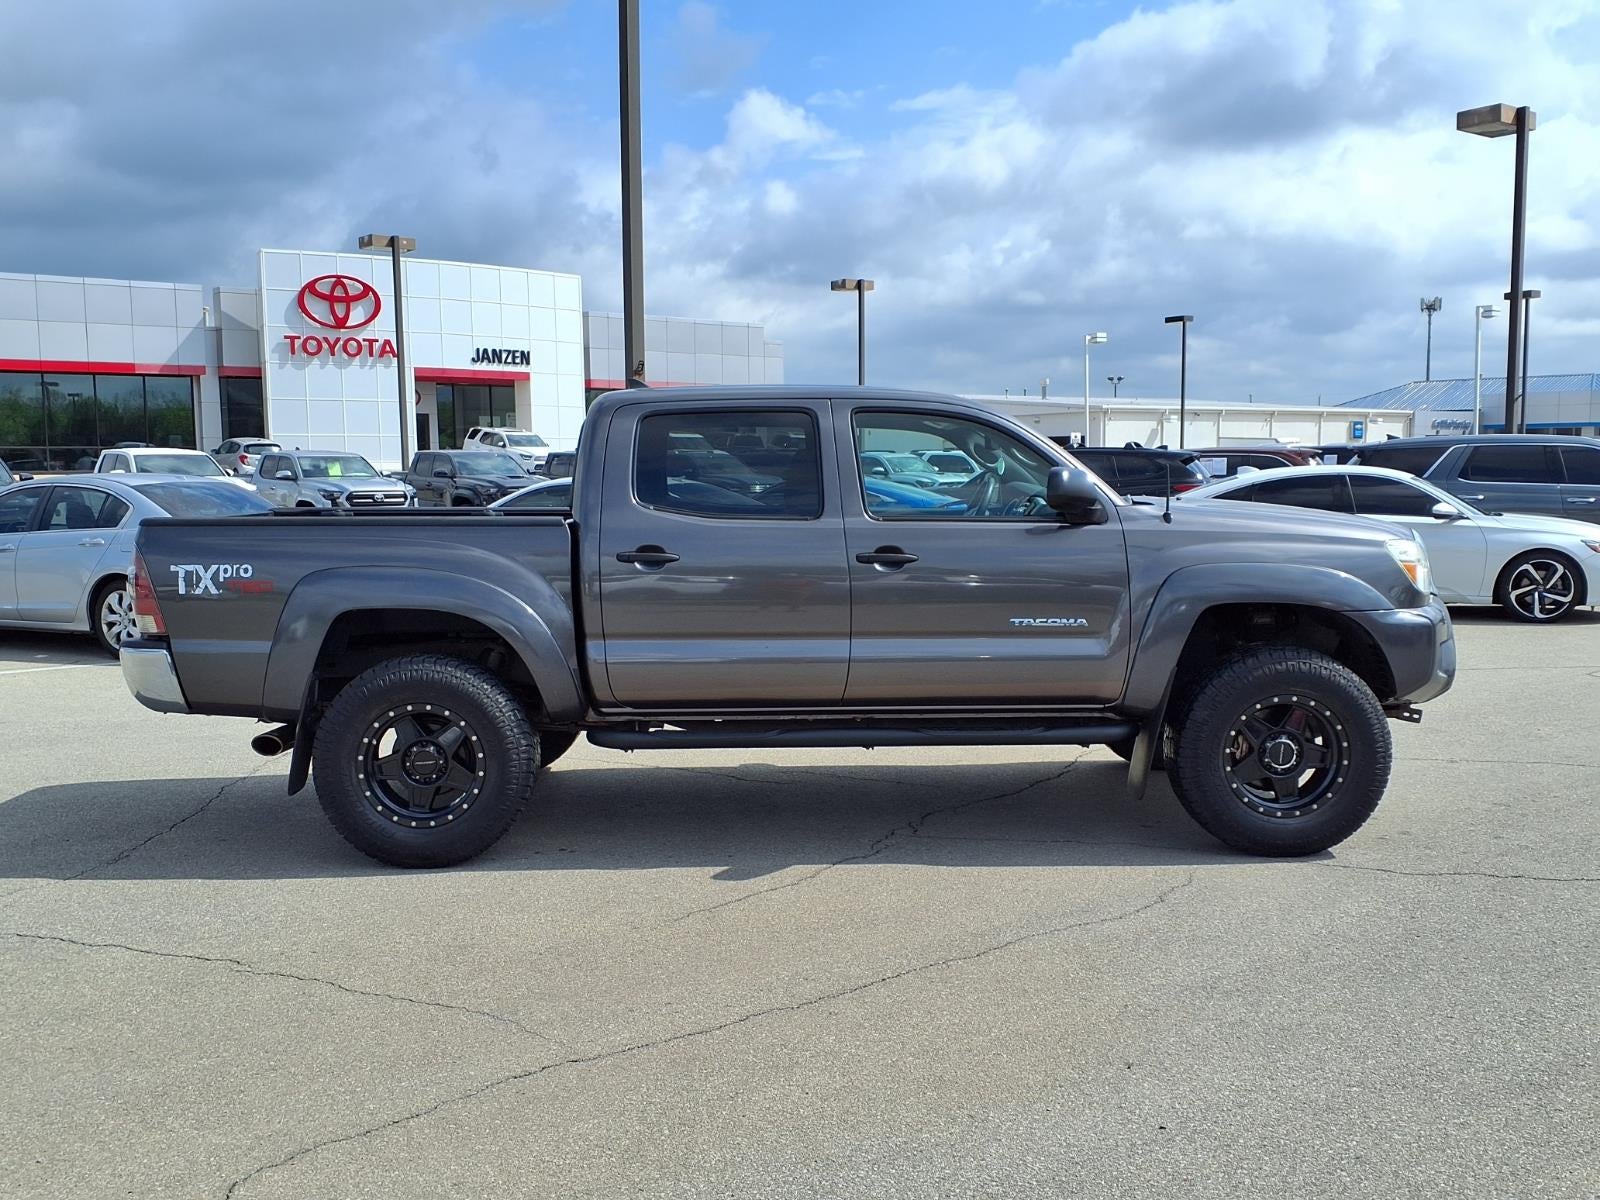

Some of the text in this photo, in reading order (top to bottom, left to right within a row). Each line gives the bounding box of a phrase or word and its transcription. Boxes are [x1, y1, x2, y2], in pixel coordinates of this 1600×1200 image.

[284, 335, 397, 358] TOYOTA
[472, 347, 530, 366] JANZEN
[1010, 618, 1089, 627] TACOMA
